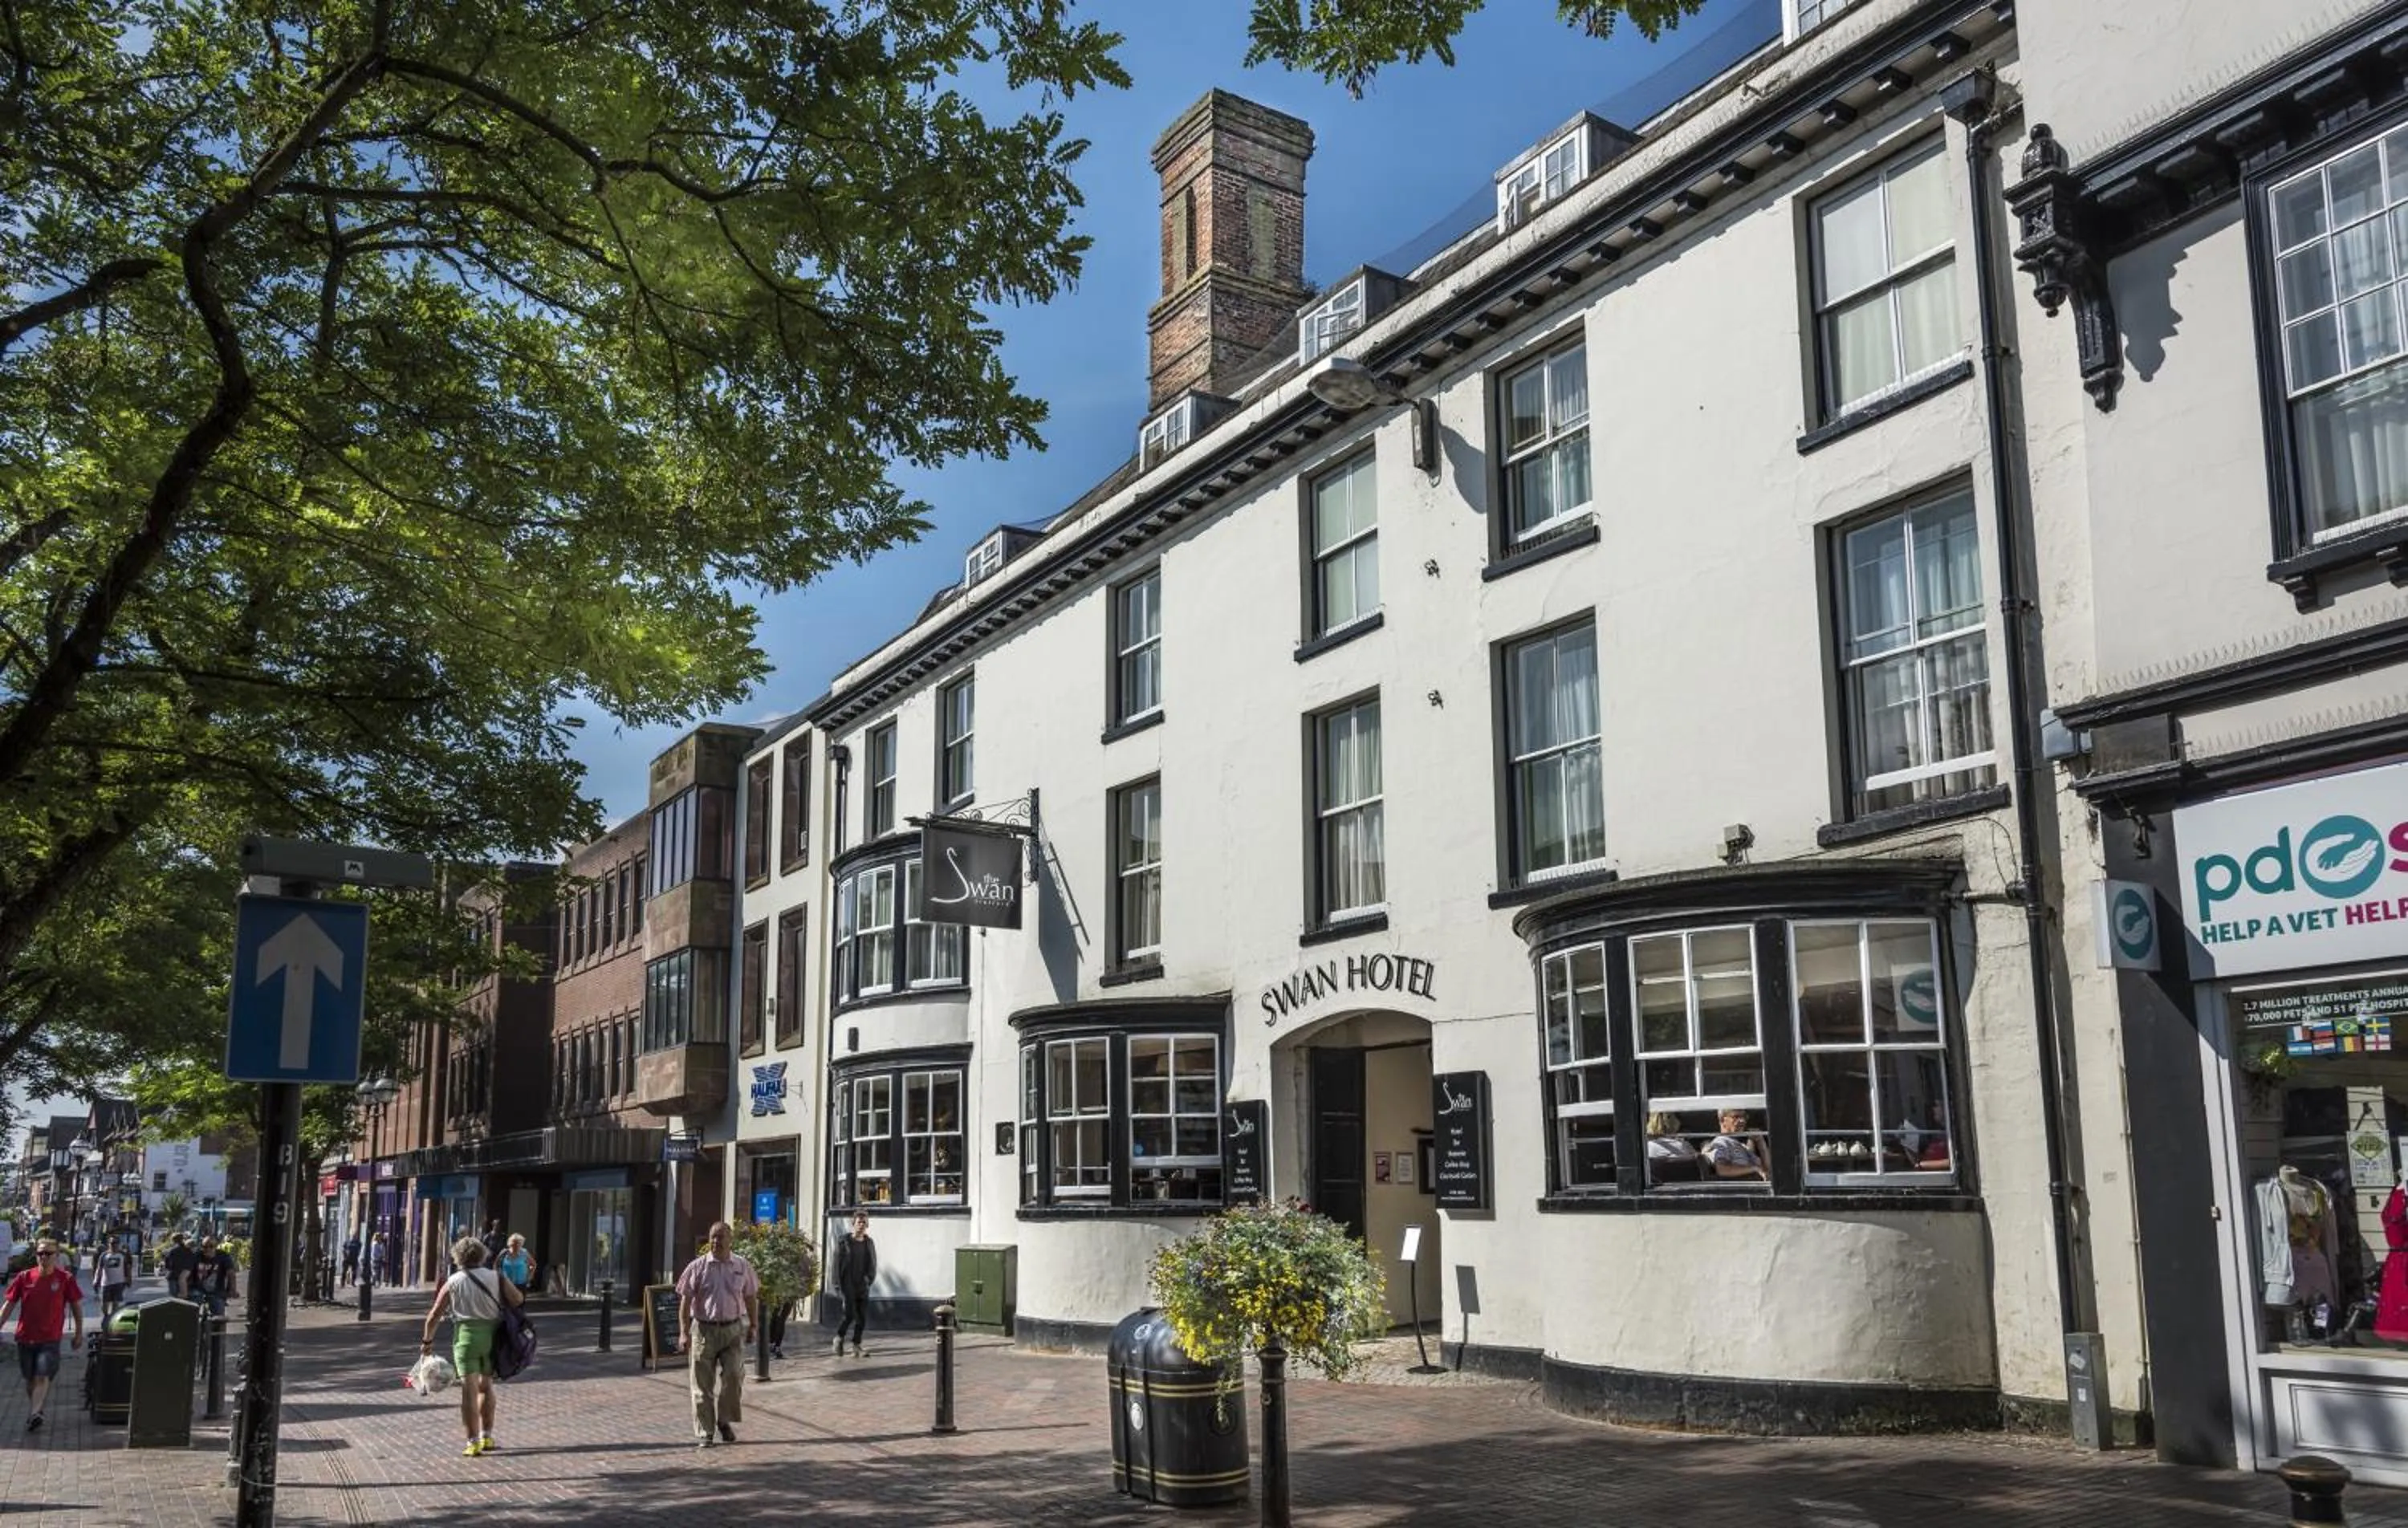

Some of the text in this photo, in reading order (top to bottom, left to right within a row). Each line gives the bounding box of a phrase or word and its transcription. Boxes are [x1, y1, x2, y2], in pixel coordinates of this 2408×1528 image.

[930, 847, 1015, 904] Swan
[2201, 919, 2261, 945] HELP
[2266, 916, 2286, 937] A
[2287, 908, 2338, 933] VET
[1261, 953, 1437, 1027] SWAN HOTEL
[2260, 997, 2300, 1009] MILLION
[2302, 990, 2369, 1005] TREATMENTS
[2333, 1004, 2346, 1014] 51
